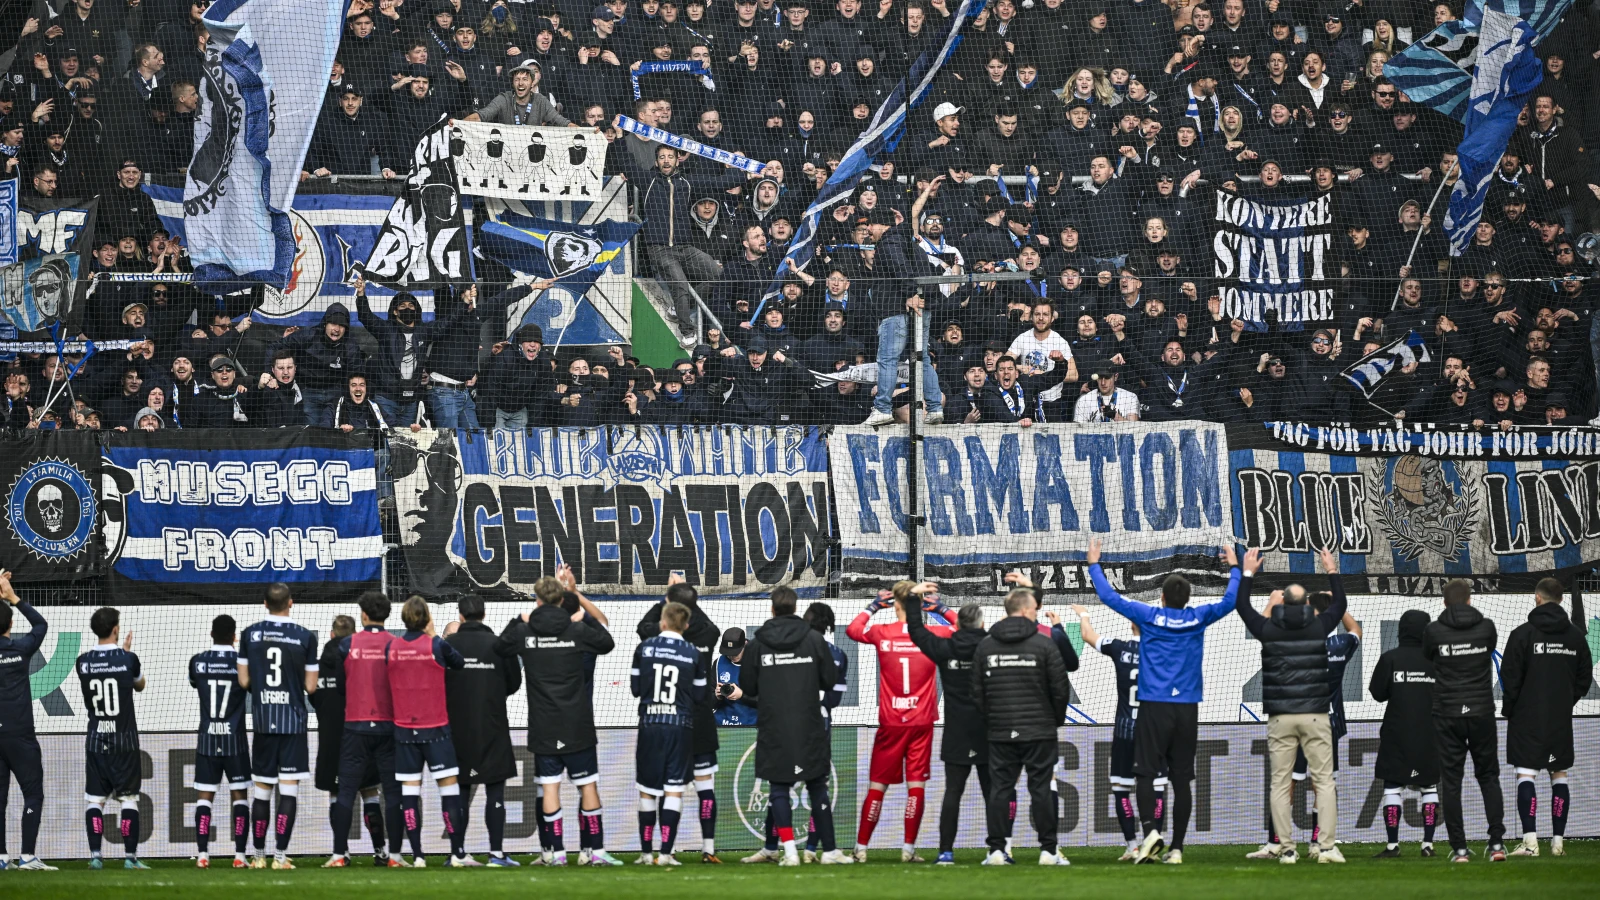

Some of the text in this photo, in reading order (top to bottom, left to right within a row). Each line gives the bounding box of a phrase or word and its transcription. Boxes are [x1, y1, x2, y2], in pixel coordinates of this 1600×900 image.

[1215, 189, 1332, 230] KONTERE
[1213, 229, 1331, 285] STATT
[1366, 427, 1412, 453] TAG
[1418, 430, 1484, 456] JOHR
[1545, 430, 1600, 456] JOH
[26, 465, 73, 484] LA FAMILIA
[137, 458, 353, 507] MUSEGG
[845, 428, 1223, 536] FORMATION
[13, 503, 23, 522] 2011
[81, 496, 91, 518] 1901
[1237, 468, 1373, 556] BLUE
[32, 535, 45, 548] FC
[161, 525, 338, 573] FRONT
[464, 481, 828, 588] GENERATION
[266, 646, 283, 688] 3
[652, 663, 680, 705] 13
[899, 657, 911, 695] 1
[89, 677, 121, 717] 20
[207, 679, 233, 719] 17
